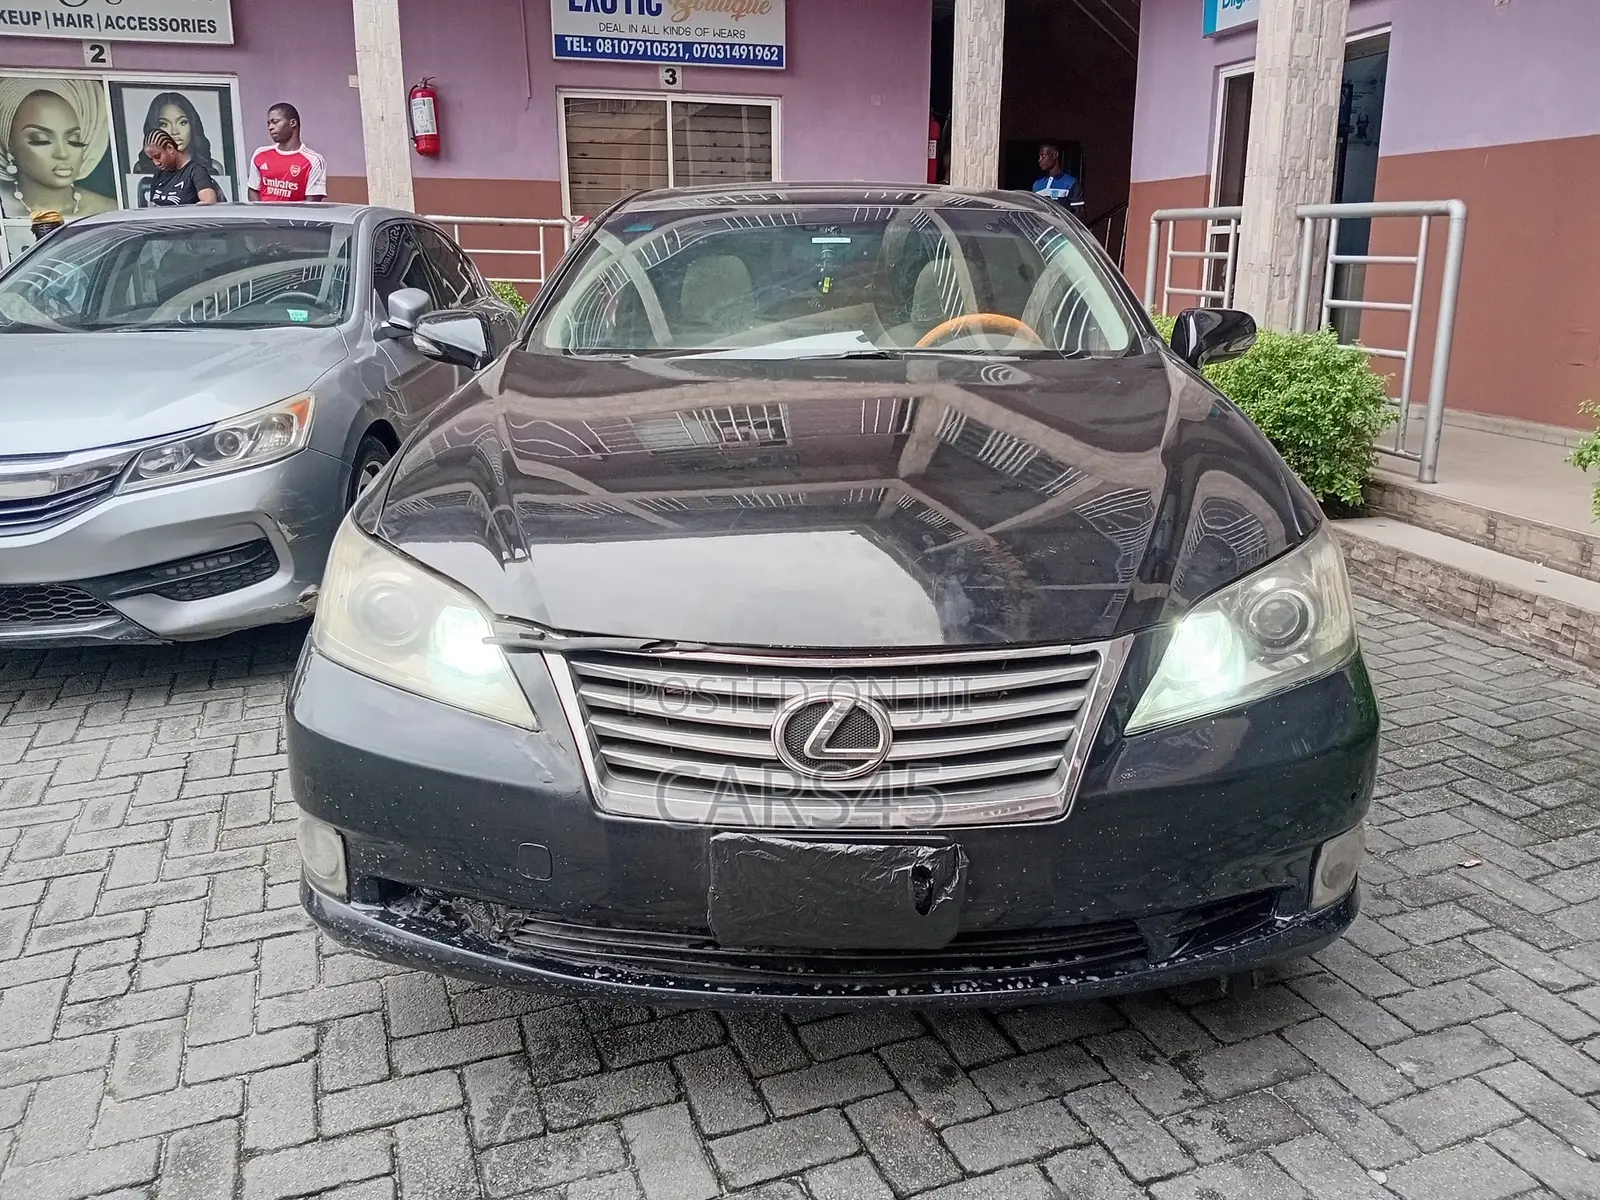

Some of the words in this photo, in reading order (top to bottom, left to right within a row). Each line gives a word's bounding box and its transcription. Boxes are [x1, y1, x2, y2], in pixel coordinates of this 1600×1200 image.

[104, 15, 217, 34] ACCESSORIES
[599, 22, 625, 33] DEAL
[628, 24, 638, 34] IN
[641, 25, 660, 35] ALL
[663, 26, 691, 37] KINDS
[694, 27, 710, 37] OF
[713, 28, 746, 39] WEARS
[89, 44, 107, 63] 2
[564, 36, 592, 53] TEL:
[596, 38, 690, 60] 08107910521,
[693, 43, 779, 61] 07031491962
[664, 67, 678, 86] 3
[262, 177, 298, 190] Emirates
